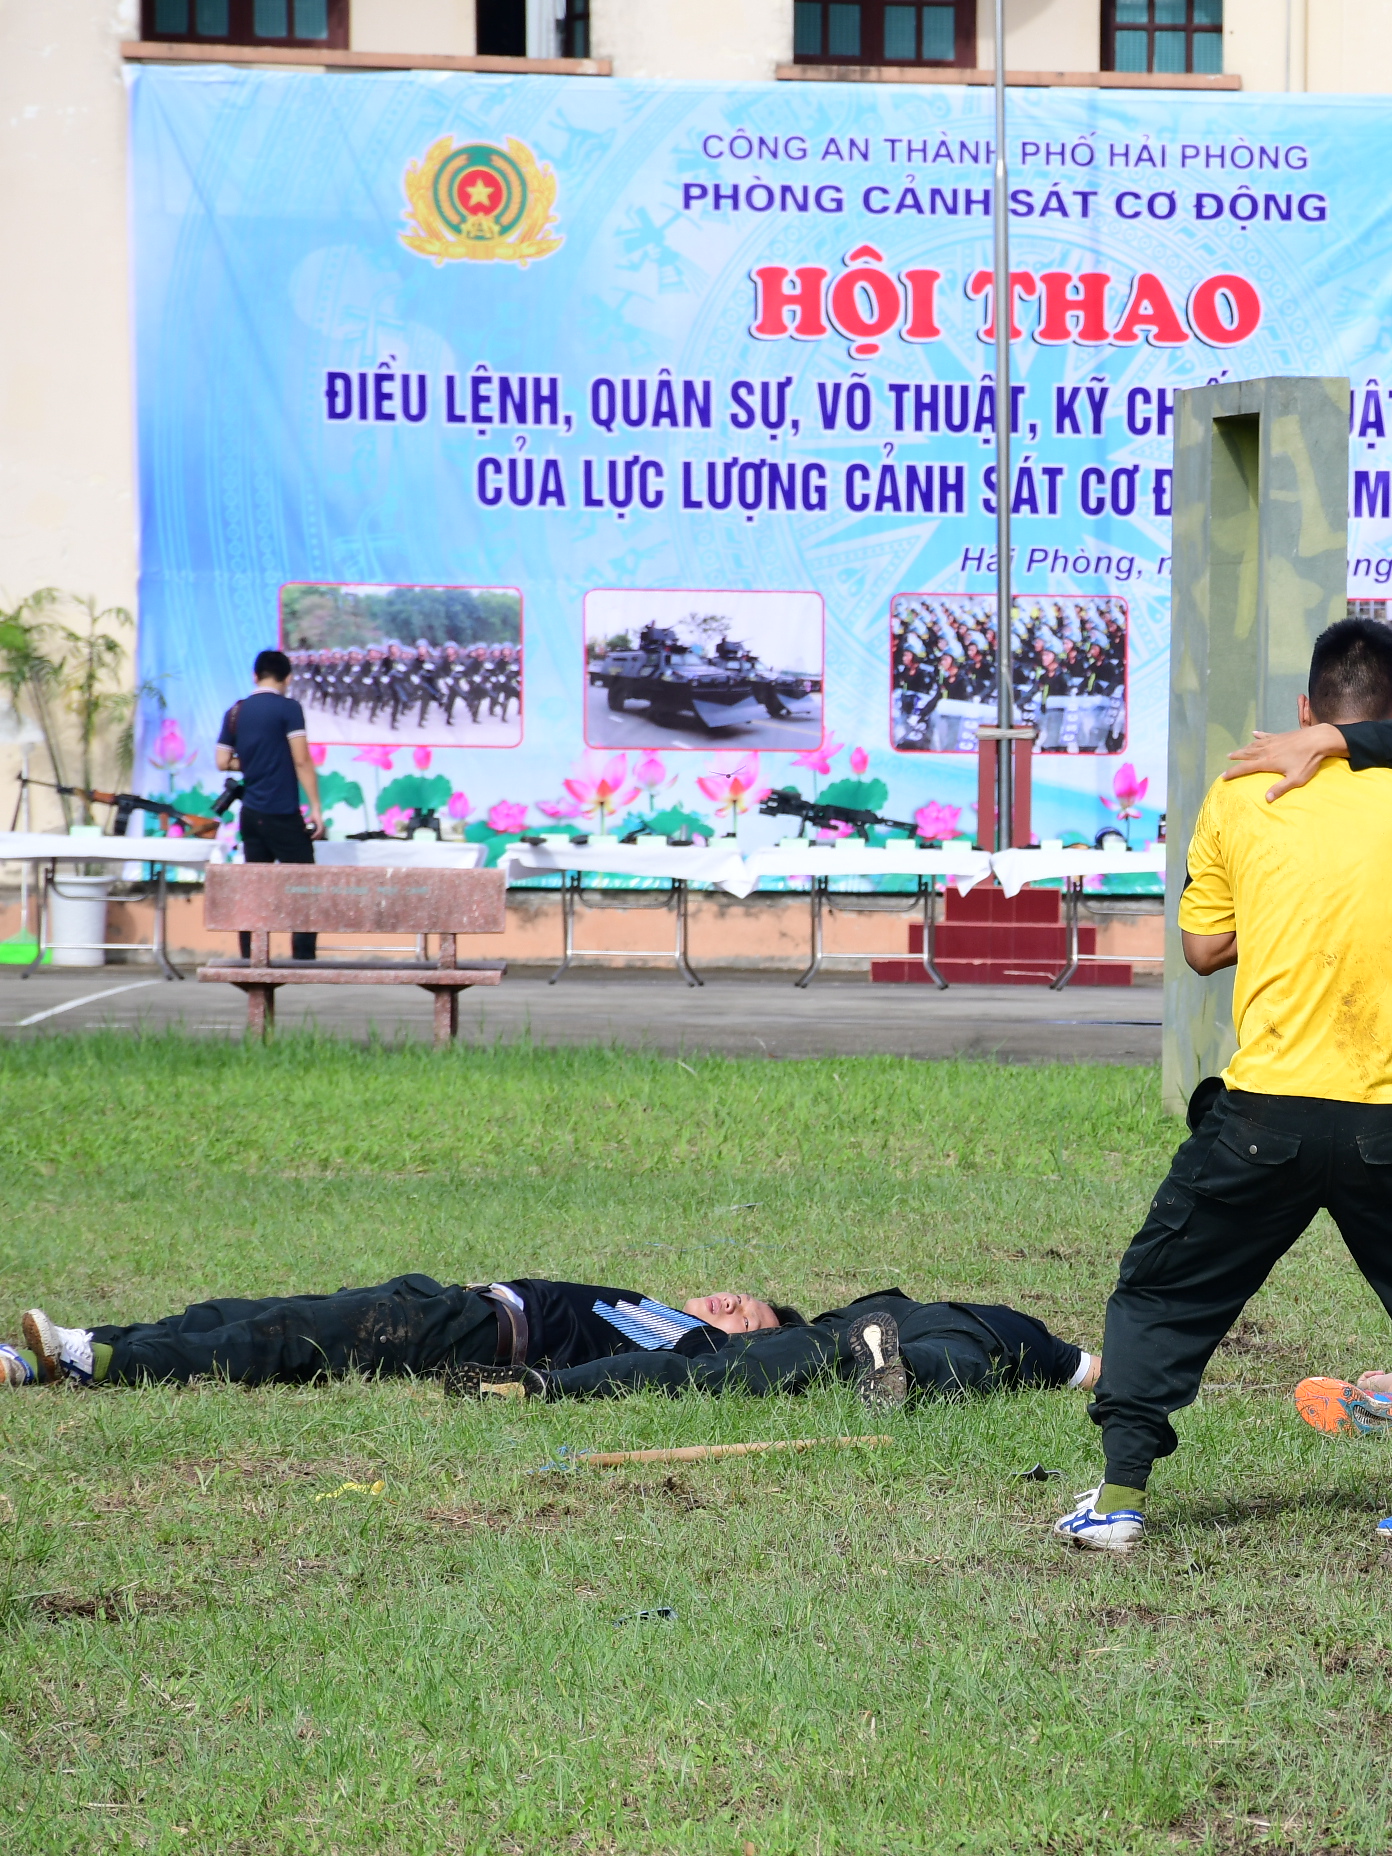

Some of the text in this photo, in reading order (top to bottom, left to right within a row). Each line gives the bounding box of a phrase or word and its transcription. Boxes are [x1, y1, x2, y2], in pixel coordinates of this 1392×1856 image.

[702, 129, 1308, 170] CÔNG AN THÀNH PHỐ HẢI PHÒNG
[682, 174, 1328, 231] PHÒNG CẢNH SÁT CƠ ĐỘNG
[753, 244, 1262, 356] HỘI THAO
[324, 354, 427, 423] ĐIỀU
[444, 364, 573, 435] LỆNH,
[590, 368, 713, 434] QUÂN
[730, 376, 800, 441] SỰ,
[817, 372, 872, 432] VÕ
[888, 374, 1038, 445] THUẬT,
[1056, 375, 1110, 435] KỸ
[477, 436, 567, 507] CỦA
[583, 455, 665, 519] LỰC
[682, 456, 828, 522] LƯỢNG
[845, 442, 965, 513] CẢNH
[982, 455, 1064, 516] SÁT
[1080, 464, 1141, 517] CƠ
[1026, 547, 1143, 581] Phòng,
